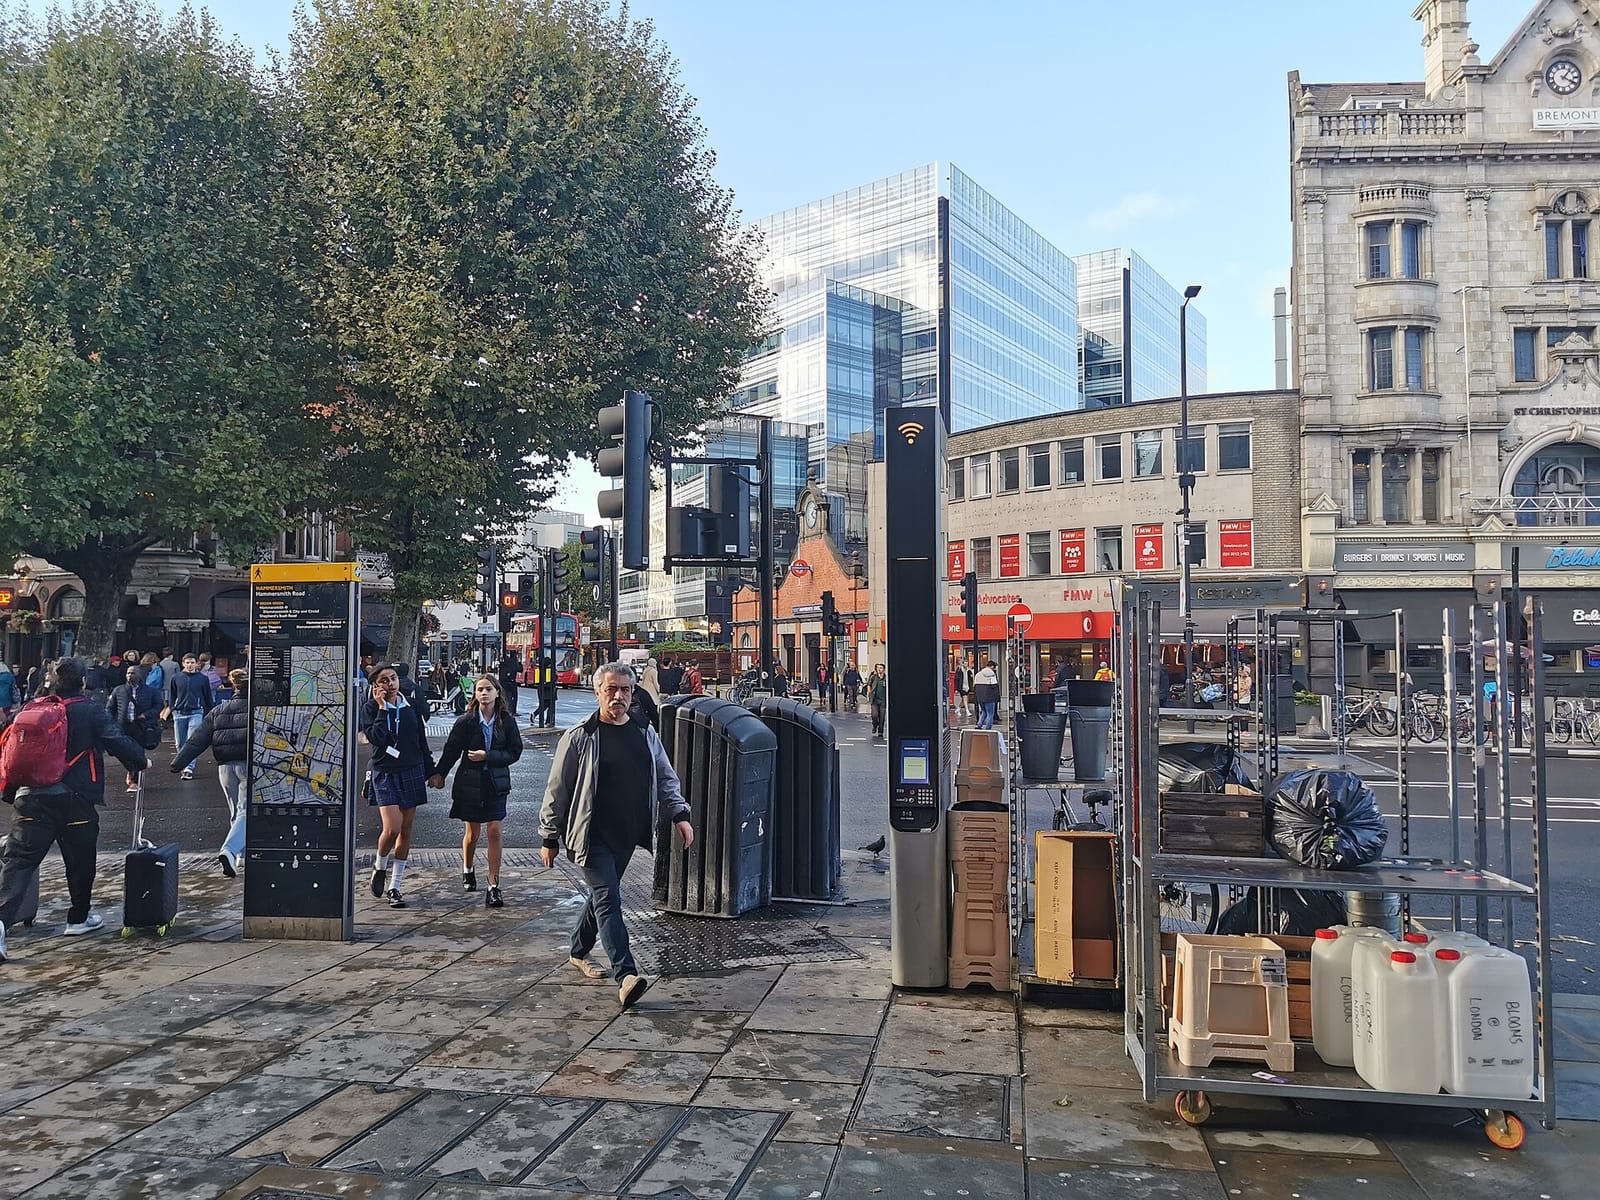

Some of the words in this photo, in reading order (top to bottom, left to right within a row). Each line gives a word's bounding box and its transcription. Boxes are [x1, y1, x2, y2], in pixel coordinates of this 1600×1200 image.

[1537, 110, 1598, 121] BREMONT
[1343, 553, 1373, 562] BURGERS
[1380, 553, 1404, 562] DRINKS
[1412, 553, 1437, 561] SPORTS
[1444, 553, 1465, 561] MUSIC
[503, 596, 516, 606] 01
[978, 593, 1021, 605] Advocates
[1063, 589, 1093, 601] FMW
[1572, 609, 1600, 621] Bel
[1469, 997, 1483, 1041] LONDON
